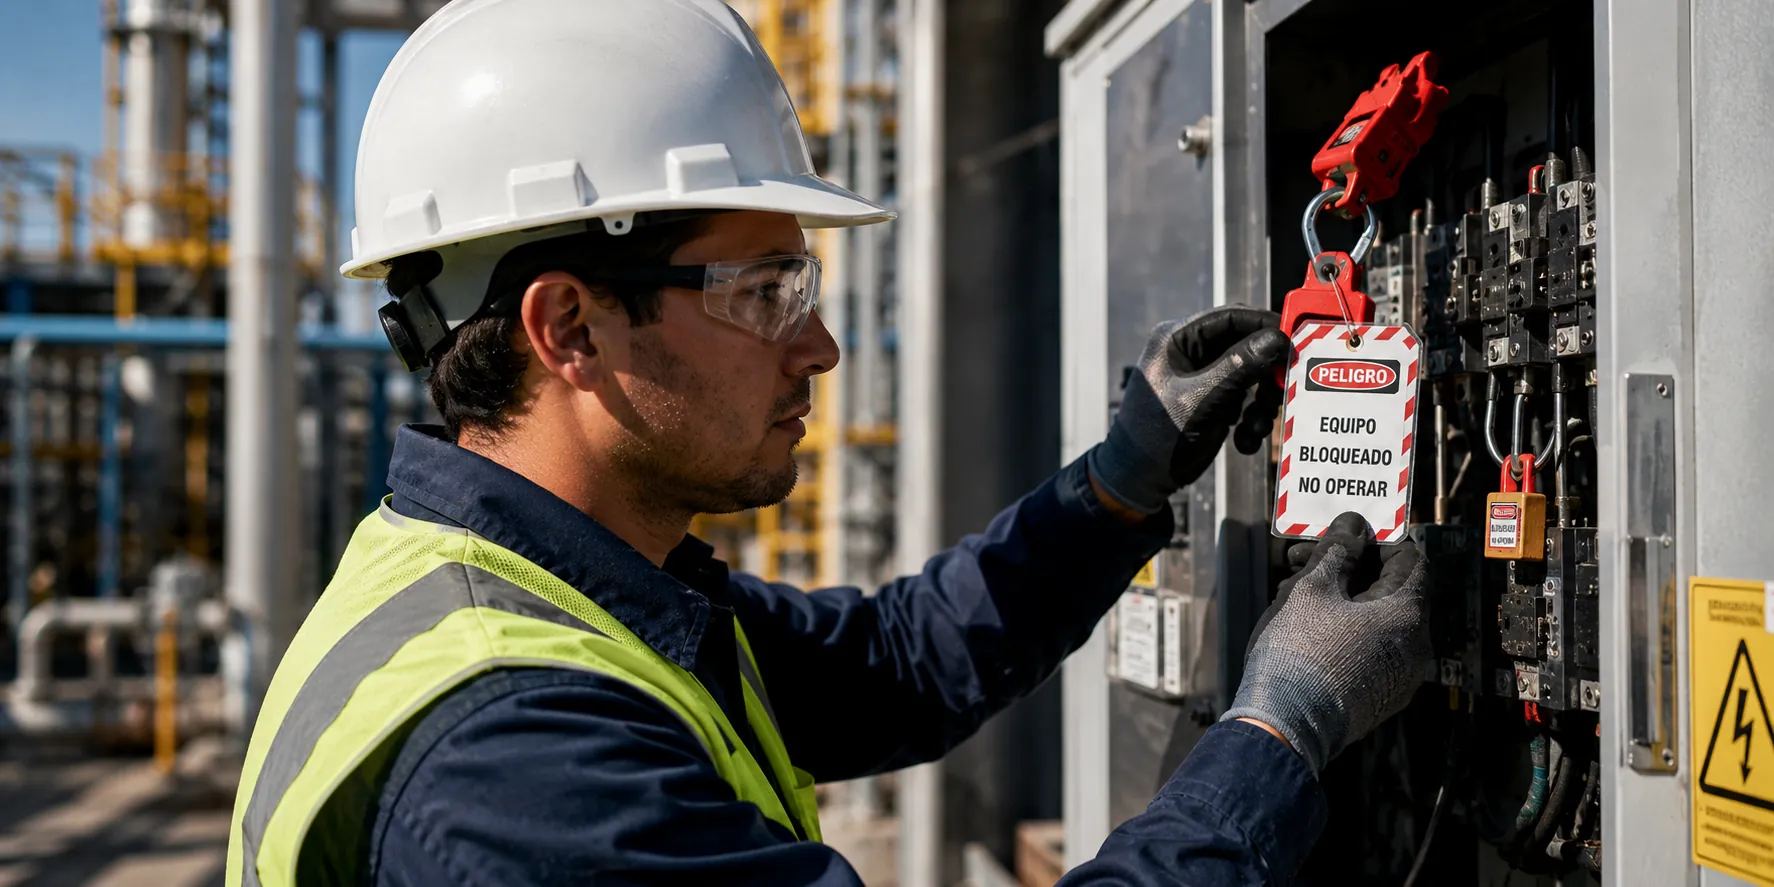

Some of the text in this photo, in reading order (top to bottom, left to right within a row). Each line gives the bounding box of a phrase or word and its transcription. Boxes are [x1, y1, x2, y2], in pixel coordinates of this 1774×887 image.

[1318, 367, 1388, 384] PELIGRO
[1319, 416, 1377, 435] EQUIPO
[1299, 446, 1392, 466] BLOQUEADO
[1298, 477, 1388, 498] NO OPERAR
